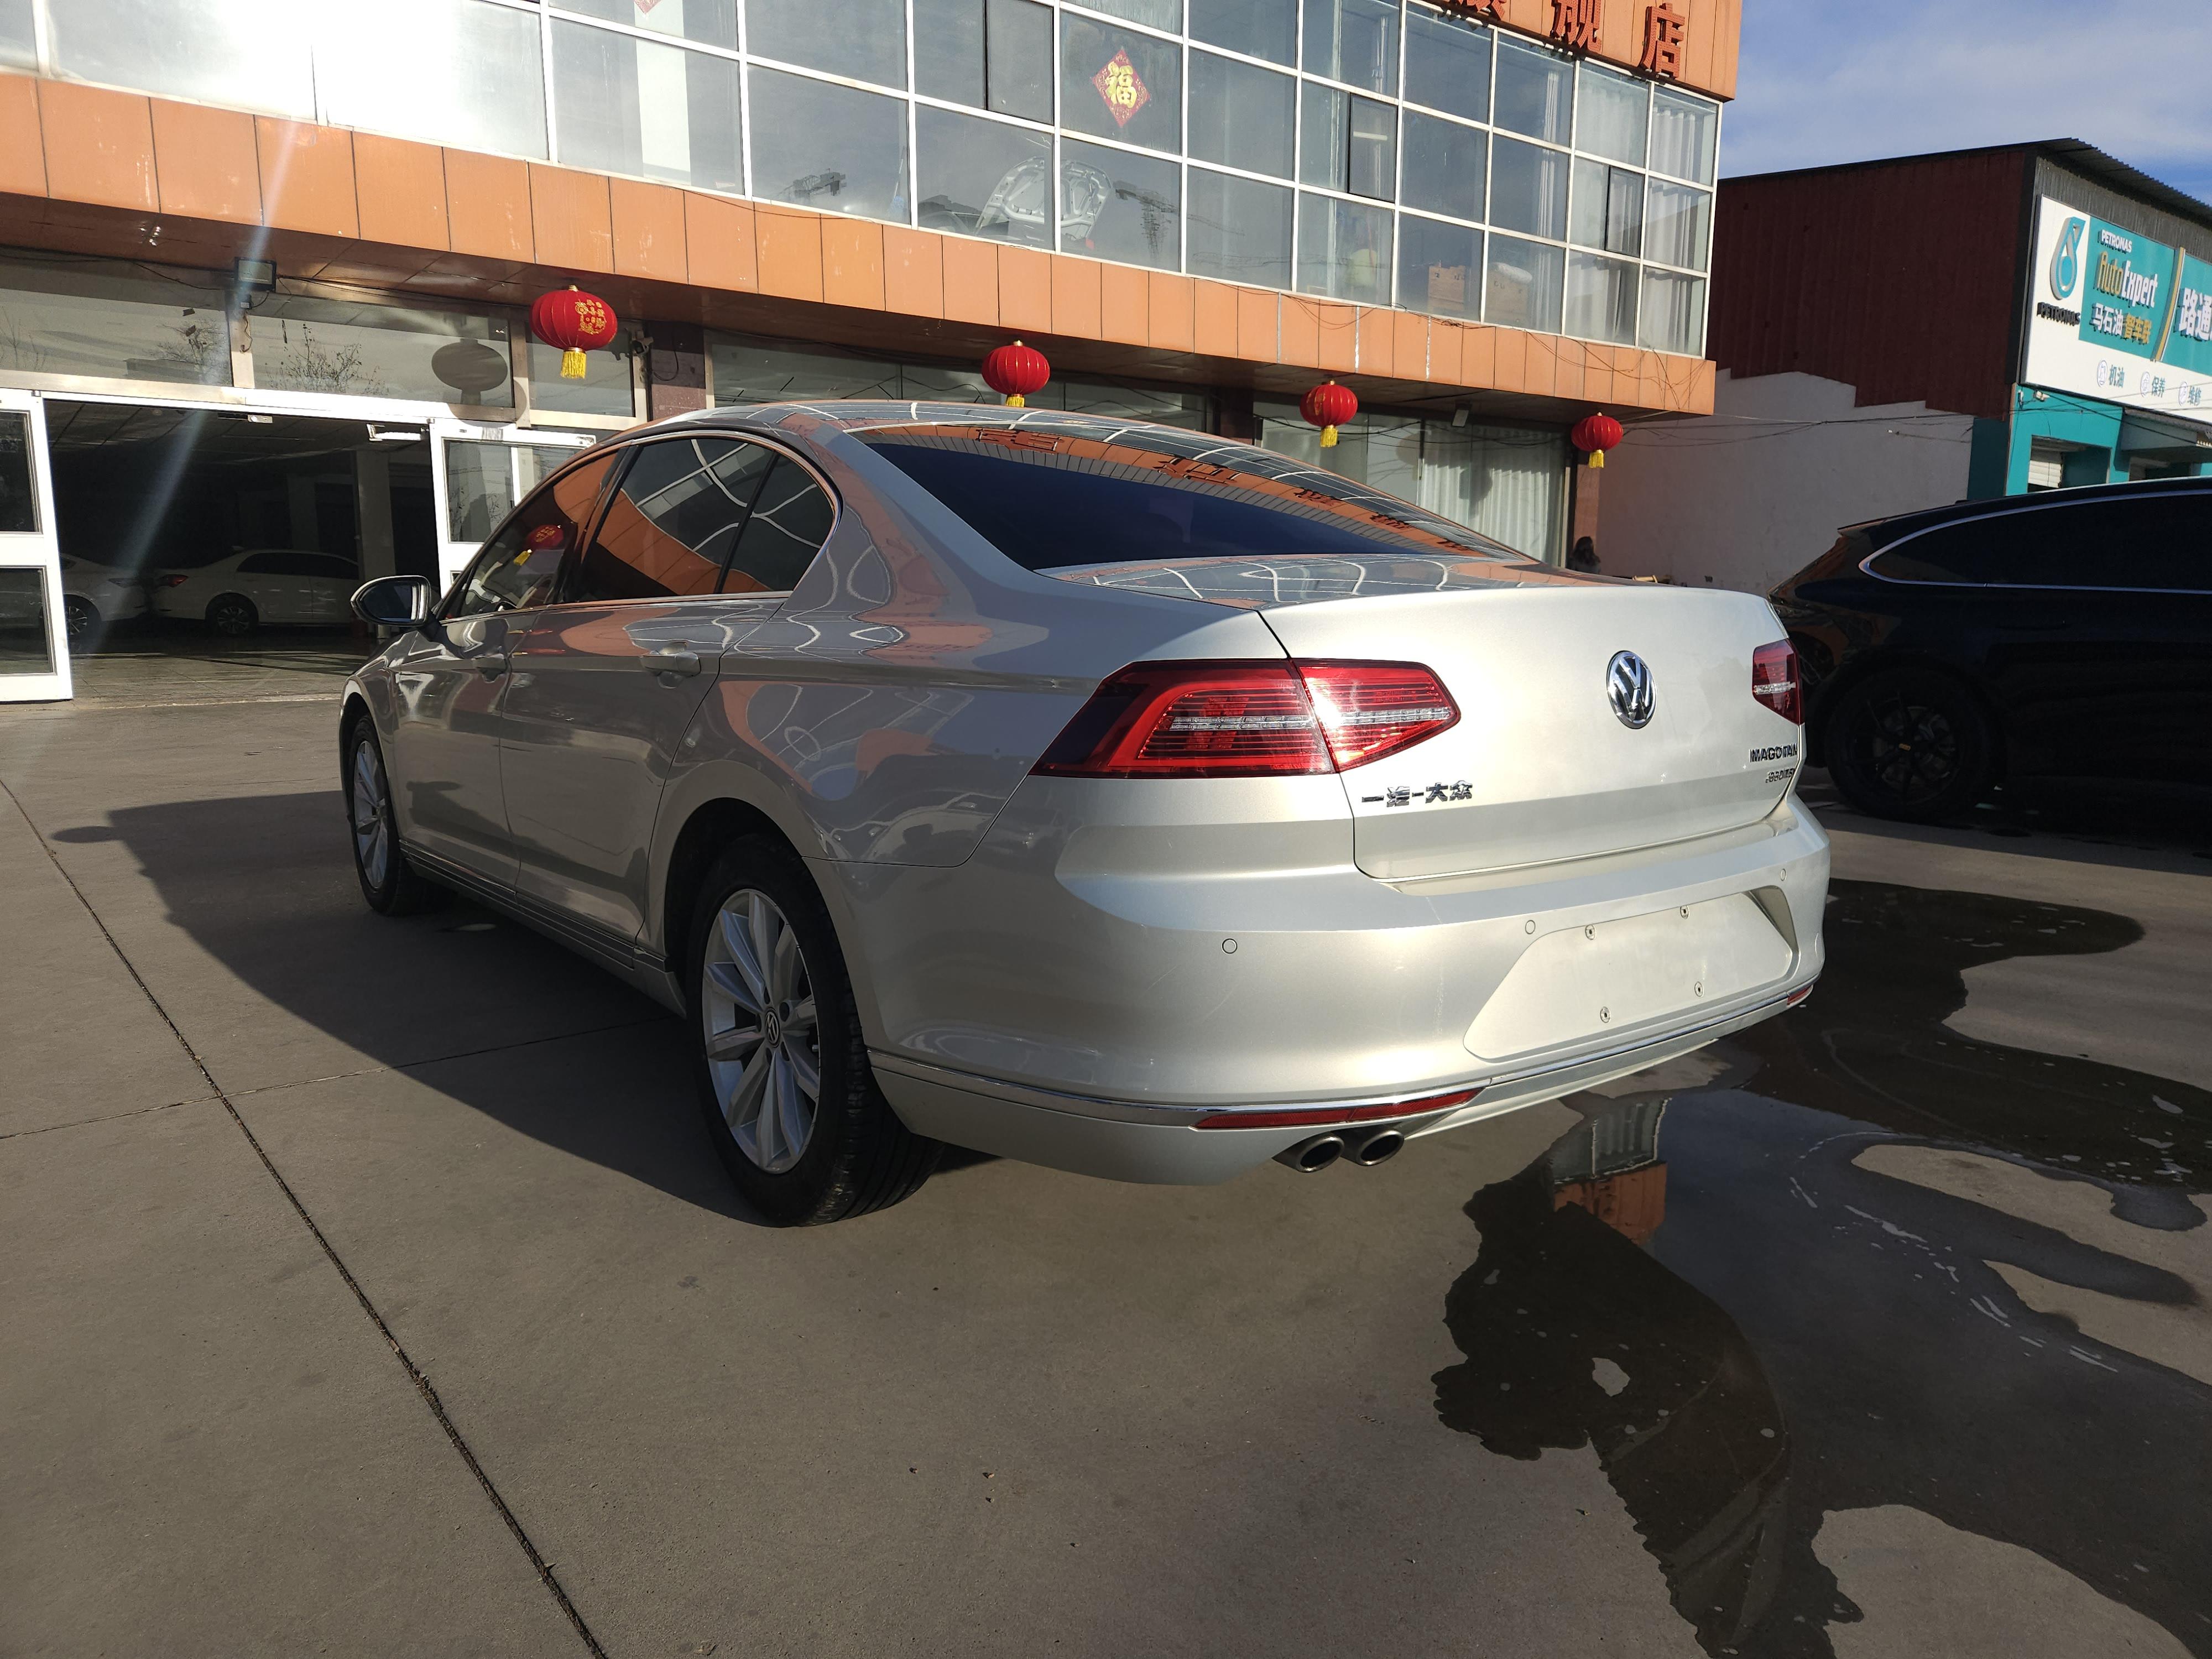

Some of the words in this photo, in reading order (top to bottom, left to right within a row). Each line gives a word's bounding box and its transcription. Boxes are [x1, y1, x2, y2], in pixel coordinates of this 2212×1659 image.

[1442, 0, 1685, 79] 舰店
[1105, 61, 1138, 109] 福
[2100, 229, 2132, 253] PETRONAS
[2037, 301, 2080, 327] PETRONAS
[2178, 287, 2212, 341] 路通
[2109, 364, 2125, 388] 机油
[2151, 375, 2166, 398] 保养
[1749, 743, 1798, 763] MAGOTAN
